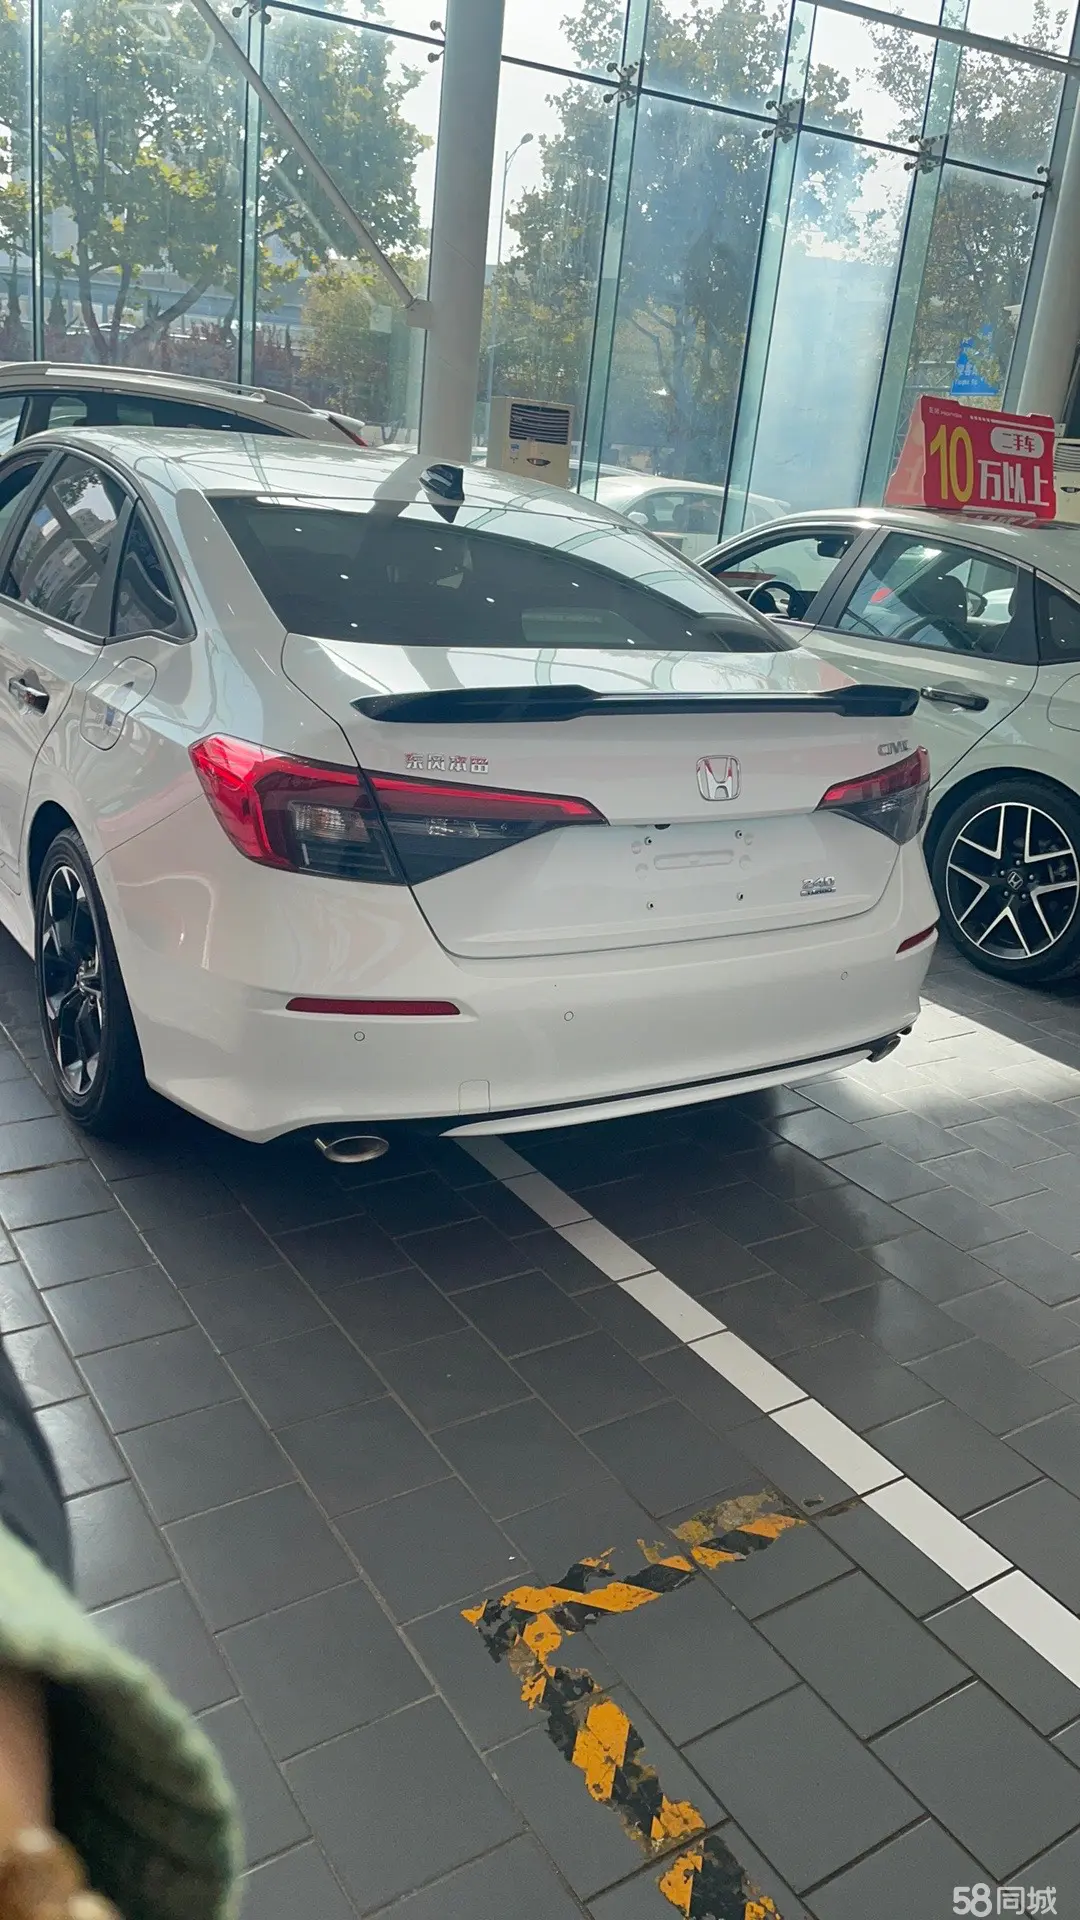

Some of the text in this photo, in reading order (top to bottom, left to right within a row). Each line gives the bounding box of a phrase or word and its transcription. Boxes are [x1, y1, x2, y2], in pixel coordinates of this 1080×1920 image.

[1002, 432, 1035, 453] 二手车
[930, 424, 974, 503] 10
[405, 752, 489, 774] 东风本田
[802, 876, 835, 889] 240
